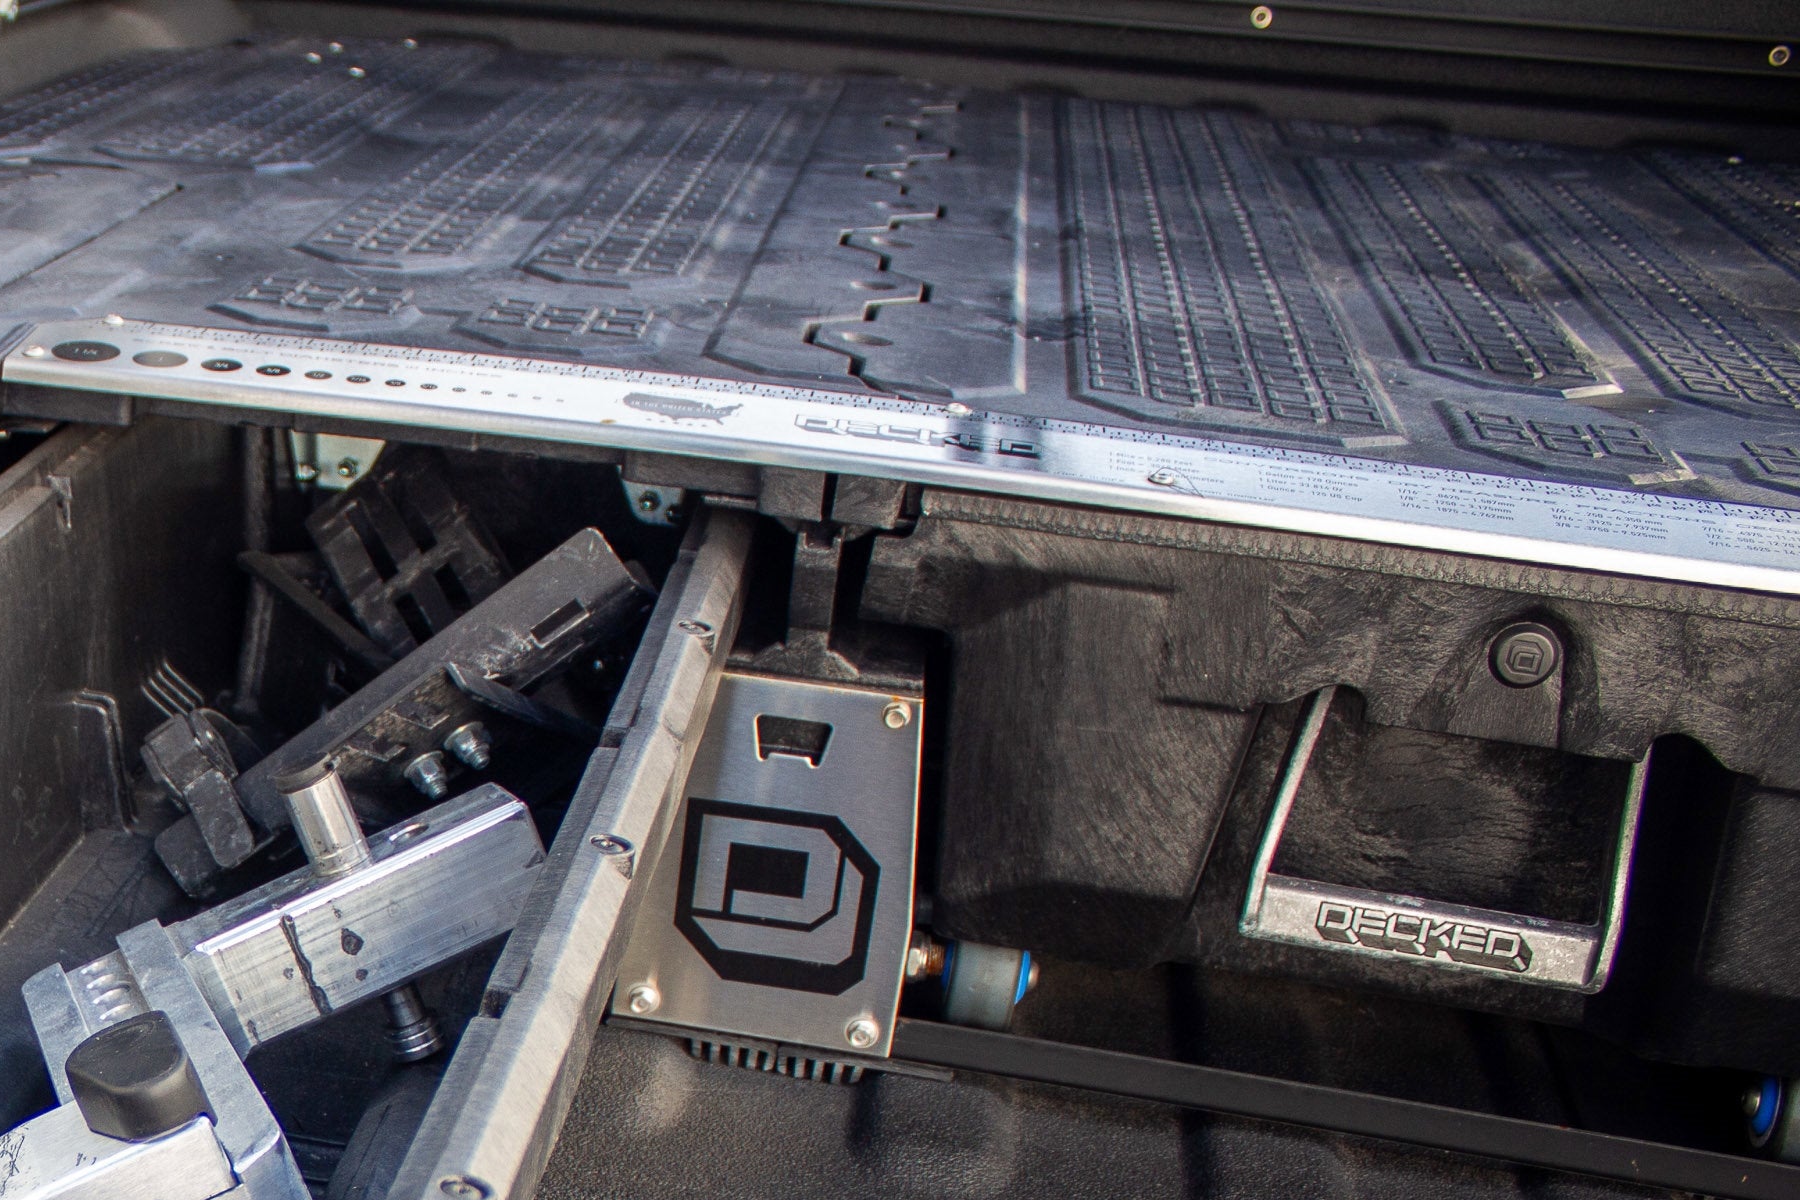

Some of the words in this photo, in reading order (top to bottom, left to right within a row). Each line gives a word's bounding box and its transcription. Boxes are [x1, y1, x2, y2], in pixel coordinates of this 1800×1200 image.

[794, 413, 1045, 460] DECKED
[1576, 502, 1716, 525] FRACTIONS
[1316, 901, 1533, 973] DECKED
